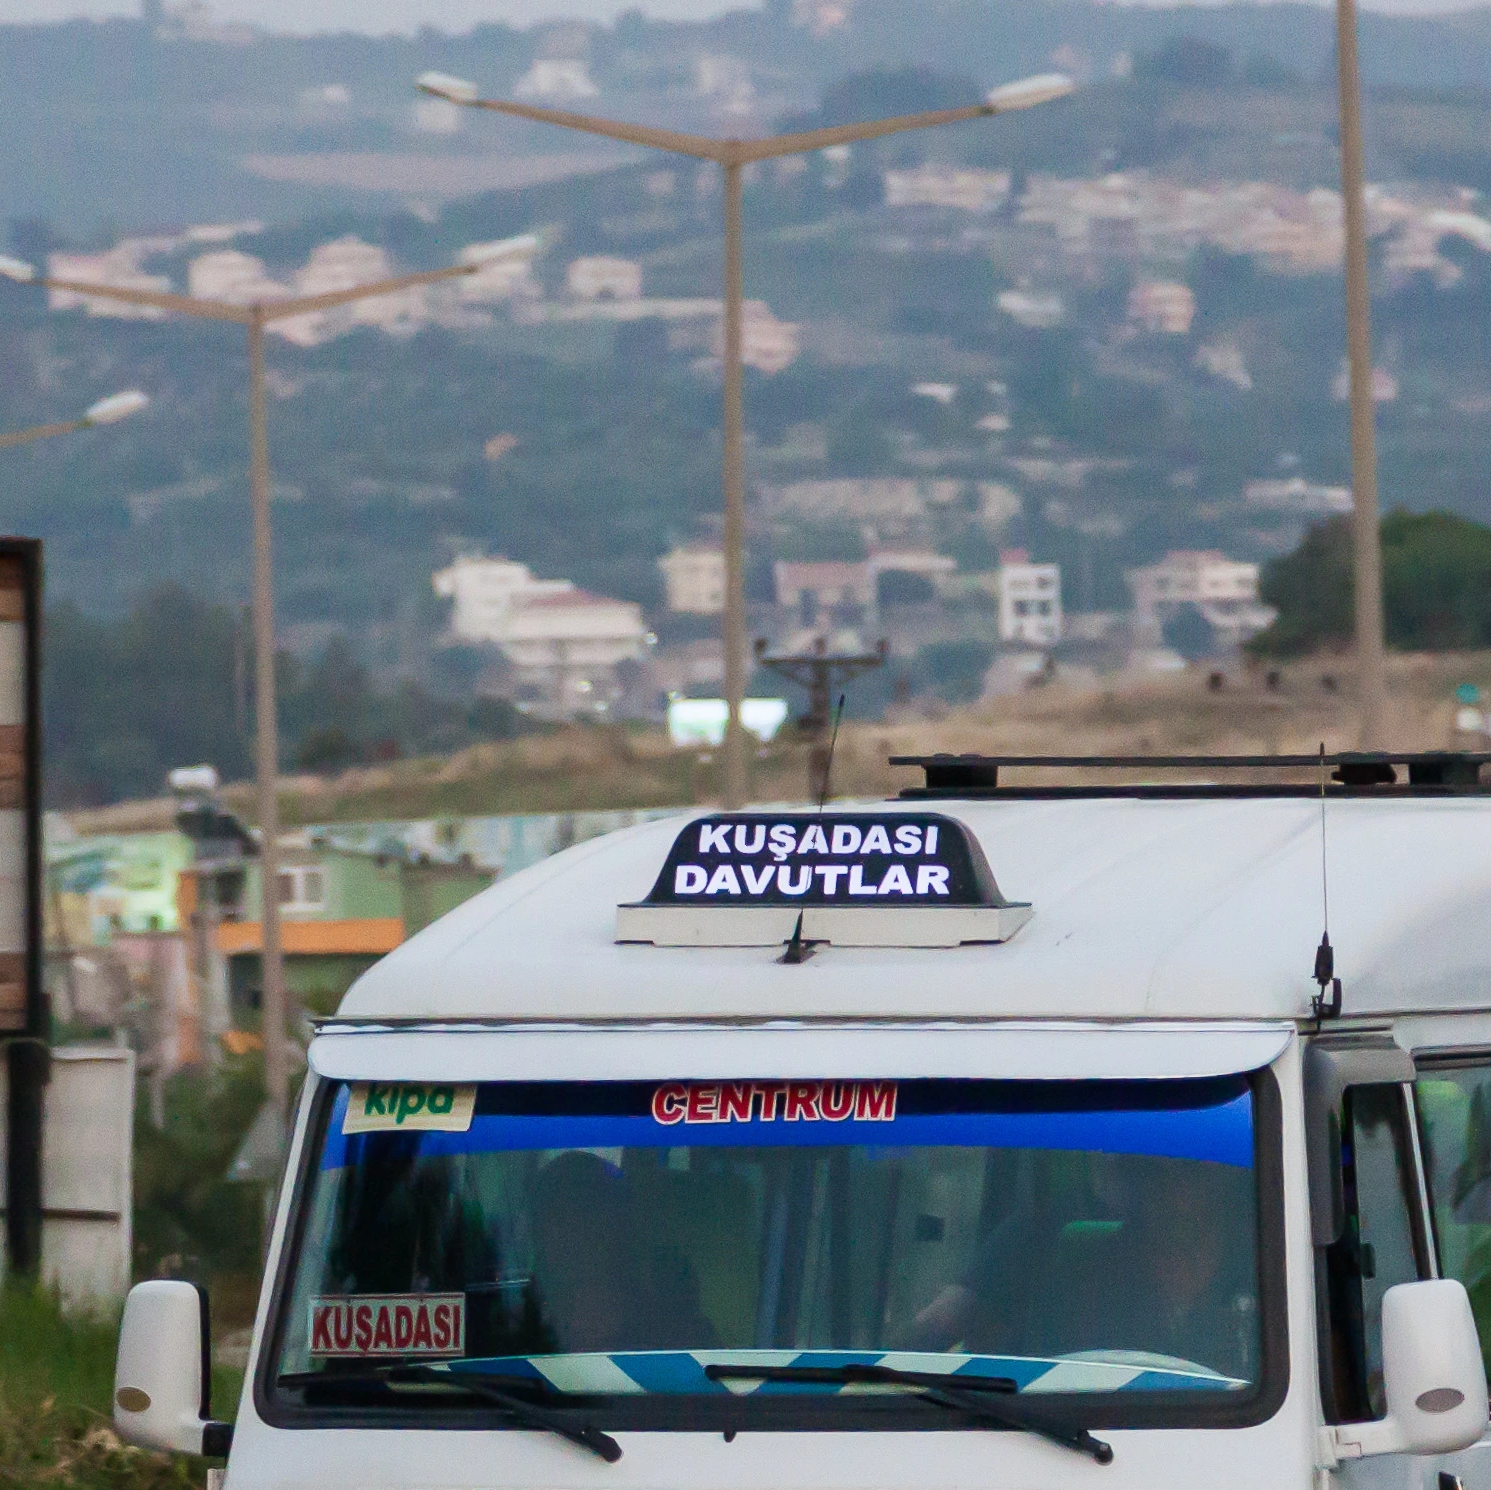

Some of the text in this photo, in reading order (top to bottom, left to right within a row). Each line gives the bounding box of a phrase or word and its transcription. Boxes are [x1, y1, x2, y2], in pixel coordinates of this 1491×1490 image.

[699, 824, 939, 862] KUŞADASI
[674, 864, 950, 895] DAVUTLAR
[652, 1081, 898, 1125] CENTRUM
[312, 1303, 460, 1351] KUŞADASI
